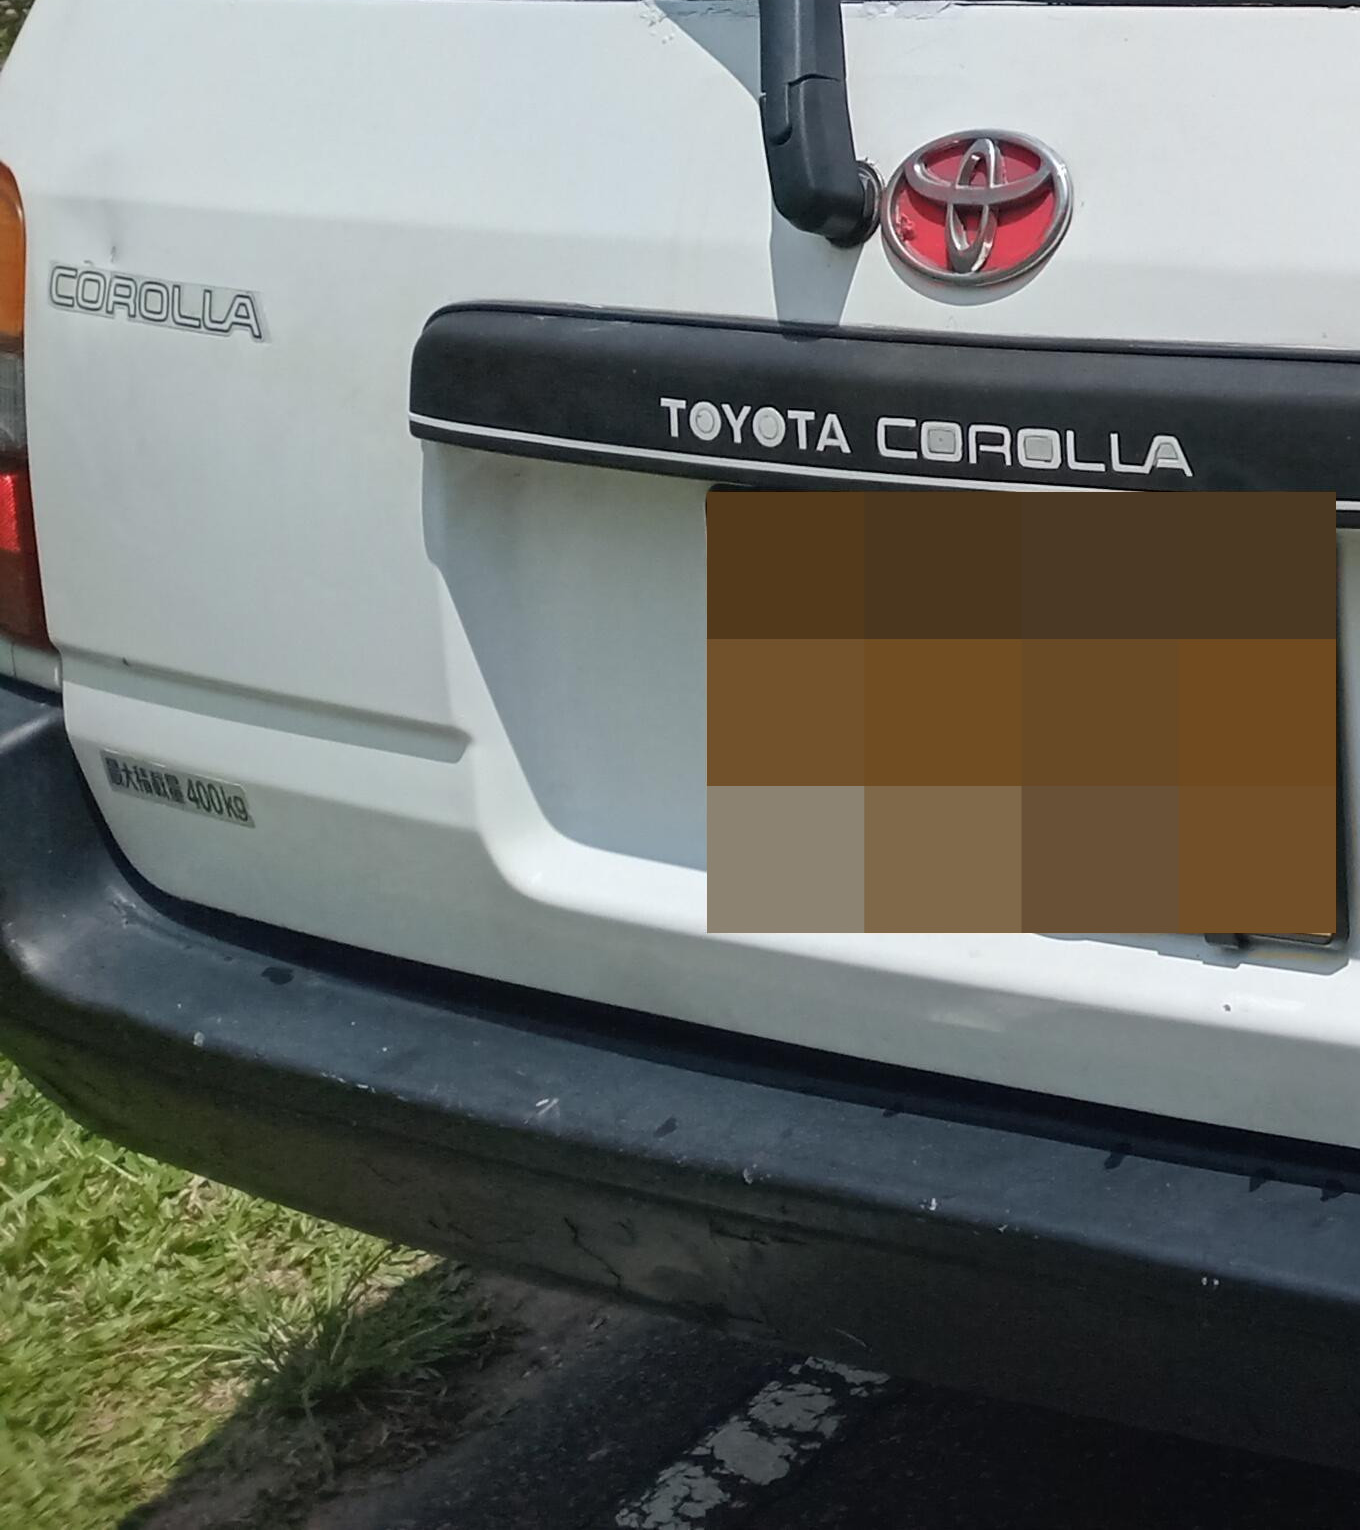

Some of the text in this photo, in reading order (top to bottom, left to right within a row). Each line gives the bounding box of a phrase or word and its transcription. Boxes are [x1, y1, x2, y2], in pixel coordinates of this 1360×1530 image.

[51, 265, 262, 339] COROLLA
[660, 397, 1194, 478] TOYOTA COROLLA
